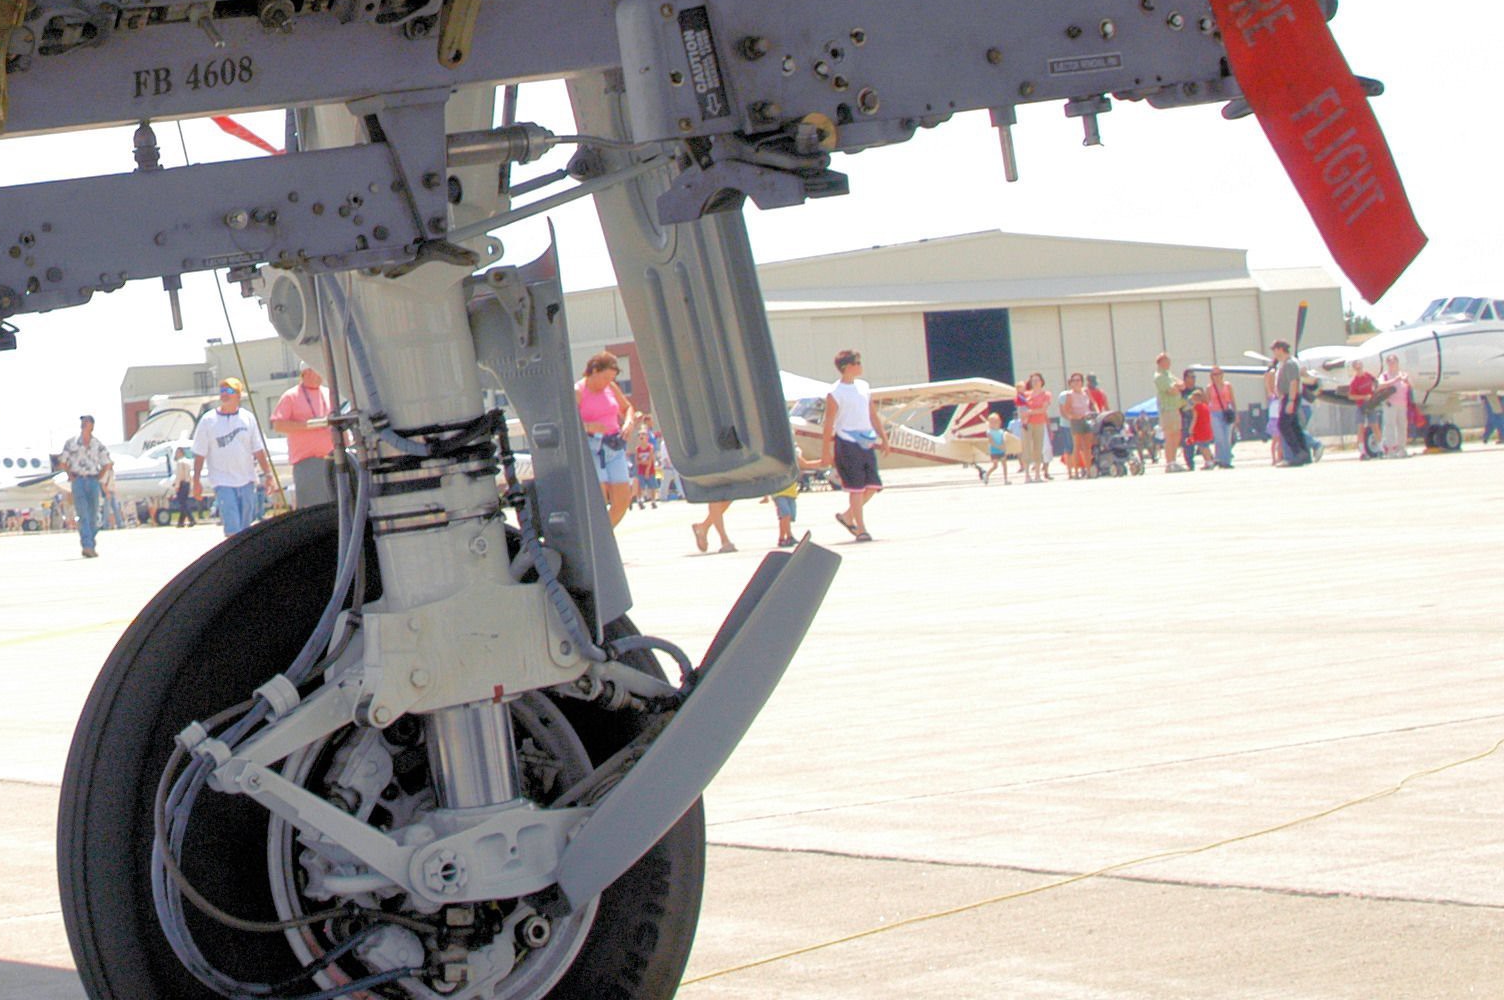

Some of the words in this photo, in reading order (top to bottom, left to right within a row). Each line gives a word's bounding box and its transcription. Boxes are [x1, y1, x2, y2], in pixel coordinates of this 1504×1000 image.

[133, 67, 173, 98] FB
[186, 56, 253, 91] 4608
[683, 29, 708, 94] CAUTION
[1291, 87, 1385, 226] FLIGHT
